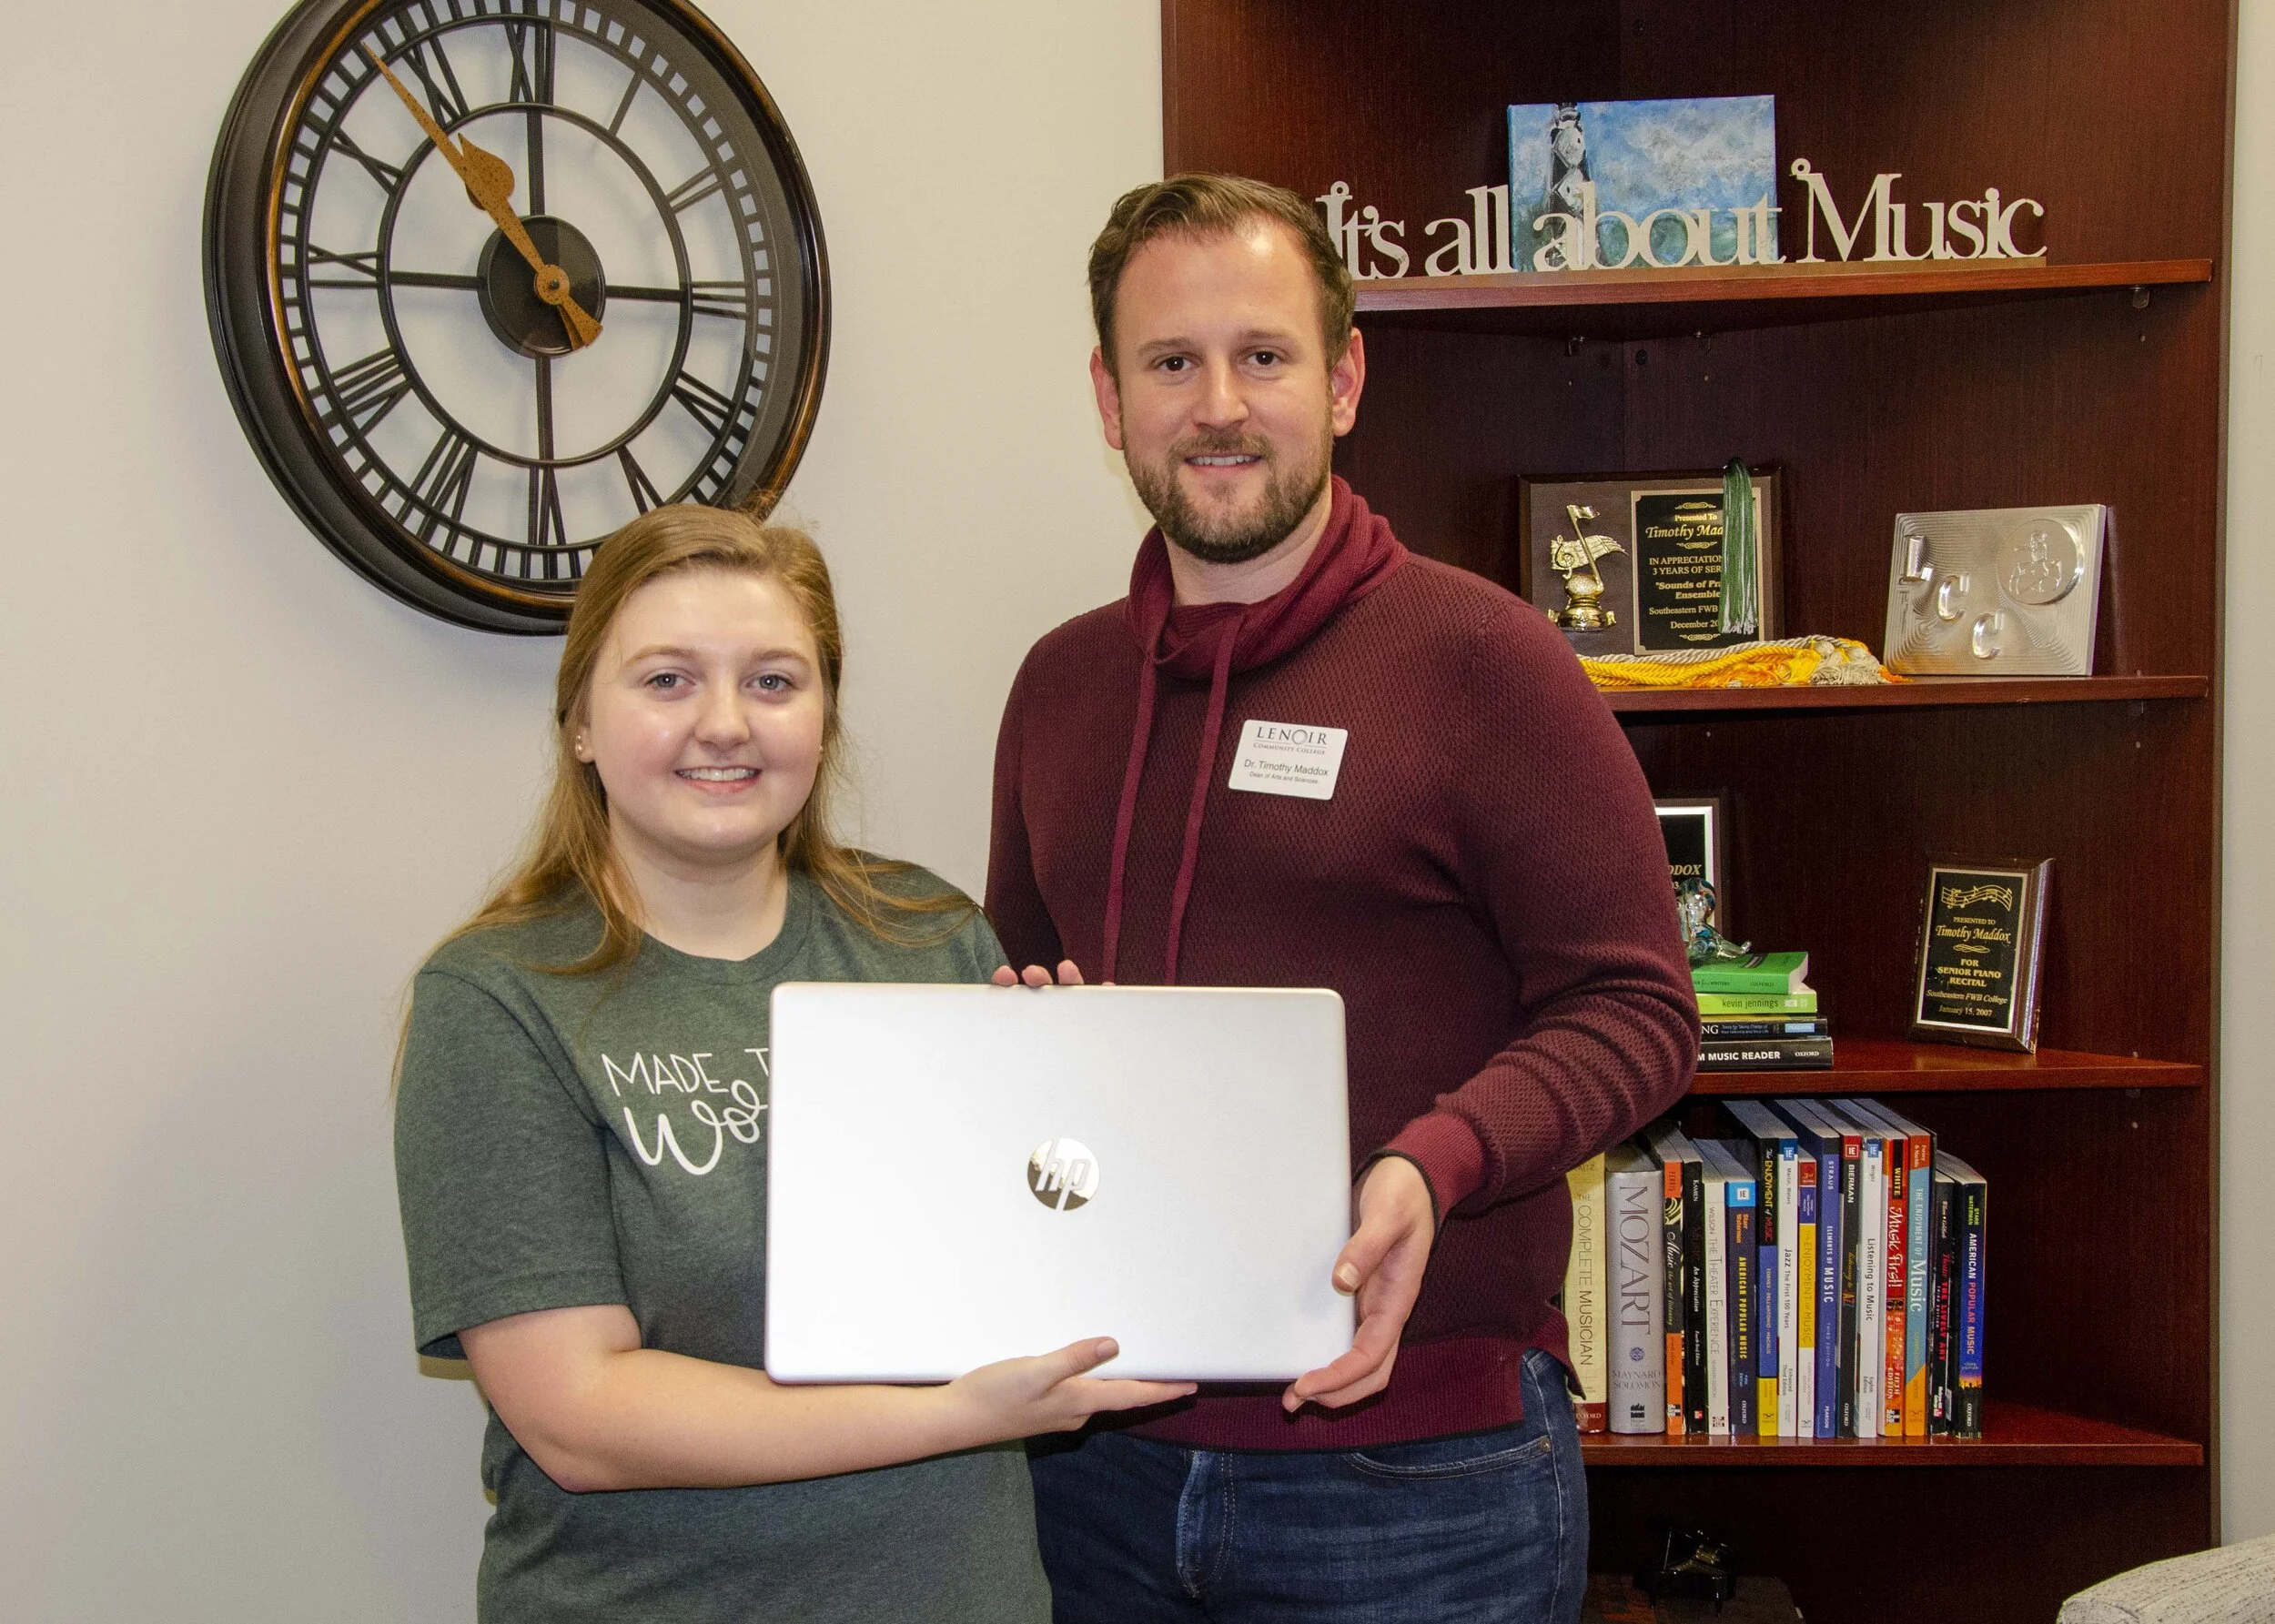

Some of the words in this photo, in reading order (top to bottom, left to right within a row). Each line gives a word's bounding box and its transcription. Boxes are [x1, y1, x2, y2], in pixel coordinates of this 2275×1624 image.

[502, 20, 558, 106] XII
[400, 35, 471, 130] XI
[607, 71, 642, 137] I
[328, 127, 407, 194] X
[664, 166, 723, 213] II
[1316, 180, 1410, 280] It's
[1424, 185, 1519, 277] all
[1532, 180, 1786, 272] about
[1790, 158, 2048, 263] Music
[308, 241, 380, 288] IX
[690, 280, 746, 318] III
[329, 348, 413, 437] VIII
[671, 368, 735, 440] IV
[528, 464, 567, 544] VI
[1674, 513, 1707, 522] Presented
[1645, 524, 1694, 540] Timothy
[1653, 568, 1658, 576] 3
[1659, 567, 1689, 575] YEARS
[1691, 566, 1704, 574] OF
[1696, 580, 1707, 588] of
[1649, 607, 1697, 615] Southeastern
[1698, 605, 1719, 613] FWB
[1670, 620, 1709, 630] December
[1253, 742, 1294, 752] COMMUNITY
[1297, 747, 1325, 755] COLLEGE
[1257, 727, 1328, 745] LENOIR
[1244, 759, 1256, 768] Dr.
[1259, 760, 1293, 773] Timothy
[1294, 764, 1329, 776] Maddox
[1249, 771, 1264, 779] Dean
[1294, 776, 1319, 784] Sciences
[1668, 863, 1702, 876] DDOX
[1936, 924, 1972, 942] Timothy
[1973, 929, 2011, 943] Maddox
[1953, 916, 1987, 924] PRESENTED
[1937, 965, 1972, 976] SENIOR
[1973, 968, 2002, 980] PIANO
[1960, 958, 1979, 967] FOR
[1949, 977, 1987, 988] RECITAL
[1722, 998, 1743, 1008] kevin
[1744, 997, 1779, 1009] jennings
[1926, 990, 1965, 1001] Southeastern
[1965, 992, 1983, 1001] FWB
[1983, 994, 2008, 1004] College
[1939, 1004, 1963, 1016] January
[1964, 1007, 1975, 1016] 15,
[1976, 1007, 1993, 1017] 2007
[1708, 1052, 1739, 1061] MUSIC
[1742, 1051, 1781, 1060] READER
[602, 1052, 729, 1097] MADE
[744, 1048, 769, 1076] T
[1765, 1147, 1774, 1160] The
[1035, 1137, 1092, 1211] hp
[1668, 1171, 1676, 1192] FERRIS
[1764, 1160, 1774, 1209] ENJOYMENT
[1847, 1164, 1855, 1204] BIERMAN
[1869, 1165, 1877, 1183] Wright
[1894, 1167, 1902, 1196] WHITE
[1916, 1187, 1924, 1201] THE
[1734, 1214, 1744, 1245] Waterman
[1764, 1216, 1773, 1243] MUSIC
[1888, 1206, 1904, 1251] Music
[1915, 1204, 1924, 1245] ENJOYMENT
[1578, 1205, 1592, 1286] COMPLETE
[1666, 1232, 1680, 1268] Music
[1708, 1238, 1718, 1255] THE
[1825, 1226, 1834, 1256] ELEMENTS
[1915, 1247, 1922, 1256] OF
[1619, 1185, 1651, 1336] MOZART
[1784, 1248, 1793, 1268] Jazz
[1826, 1256, 1834, 1265] OF
[1865, 1237, 1876, 1280] Listening
[1968, 1233, 1977, 1278] AMERICAN
[1667, 1270, 1675, 1280] the
[1694, 1266, 1700, 1276] An
[1709, 1256, 1723, 1296] THEATER
[1738, 1256, 1747, 1295] AMERICAN
[1803, 1242, 1813, 1301] ENJOYMENT
[1887, 1253, 1904, 1288] First!
[1666, 1292, 1674, 1300] of
[1693, 1276, 1701, 1312] Appreciation
[1823, 1266, 1835, 1303] MUSIC
[1866, 1282, 1874, 1292] to
[1909, 1259, 1926, 1312] Music
[1940, 1282, 1949, 1301] THE
[1666, 1300, 1674, 1326] listening
[1739, 1298, 1748, 1332] POPULAR
[1866, 1295, 1875, 1322] Music
[1967, 1282, 1977, 1323] POPULAR
[1579, 1290, 1593, 1366] MUSICIAN
[1709, 1299, 1724, 1355] EXPERIENCE
[1803, 1312, 1813, 1343] MUSIC
[1939, 1305, 1948, 1337] LIVELY
[1739, 1336, 1748, 1359] MUSIC
[1938, 1341, 1947, 1361] ART
[1967, 1326, 1977, 1355] MUSIC
[1612, 1369, 1661, 1380] MAYNARD
[1613, 1380, 1661, 1390] SOLOMON
